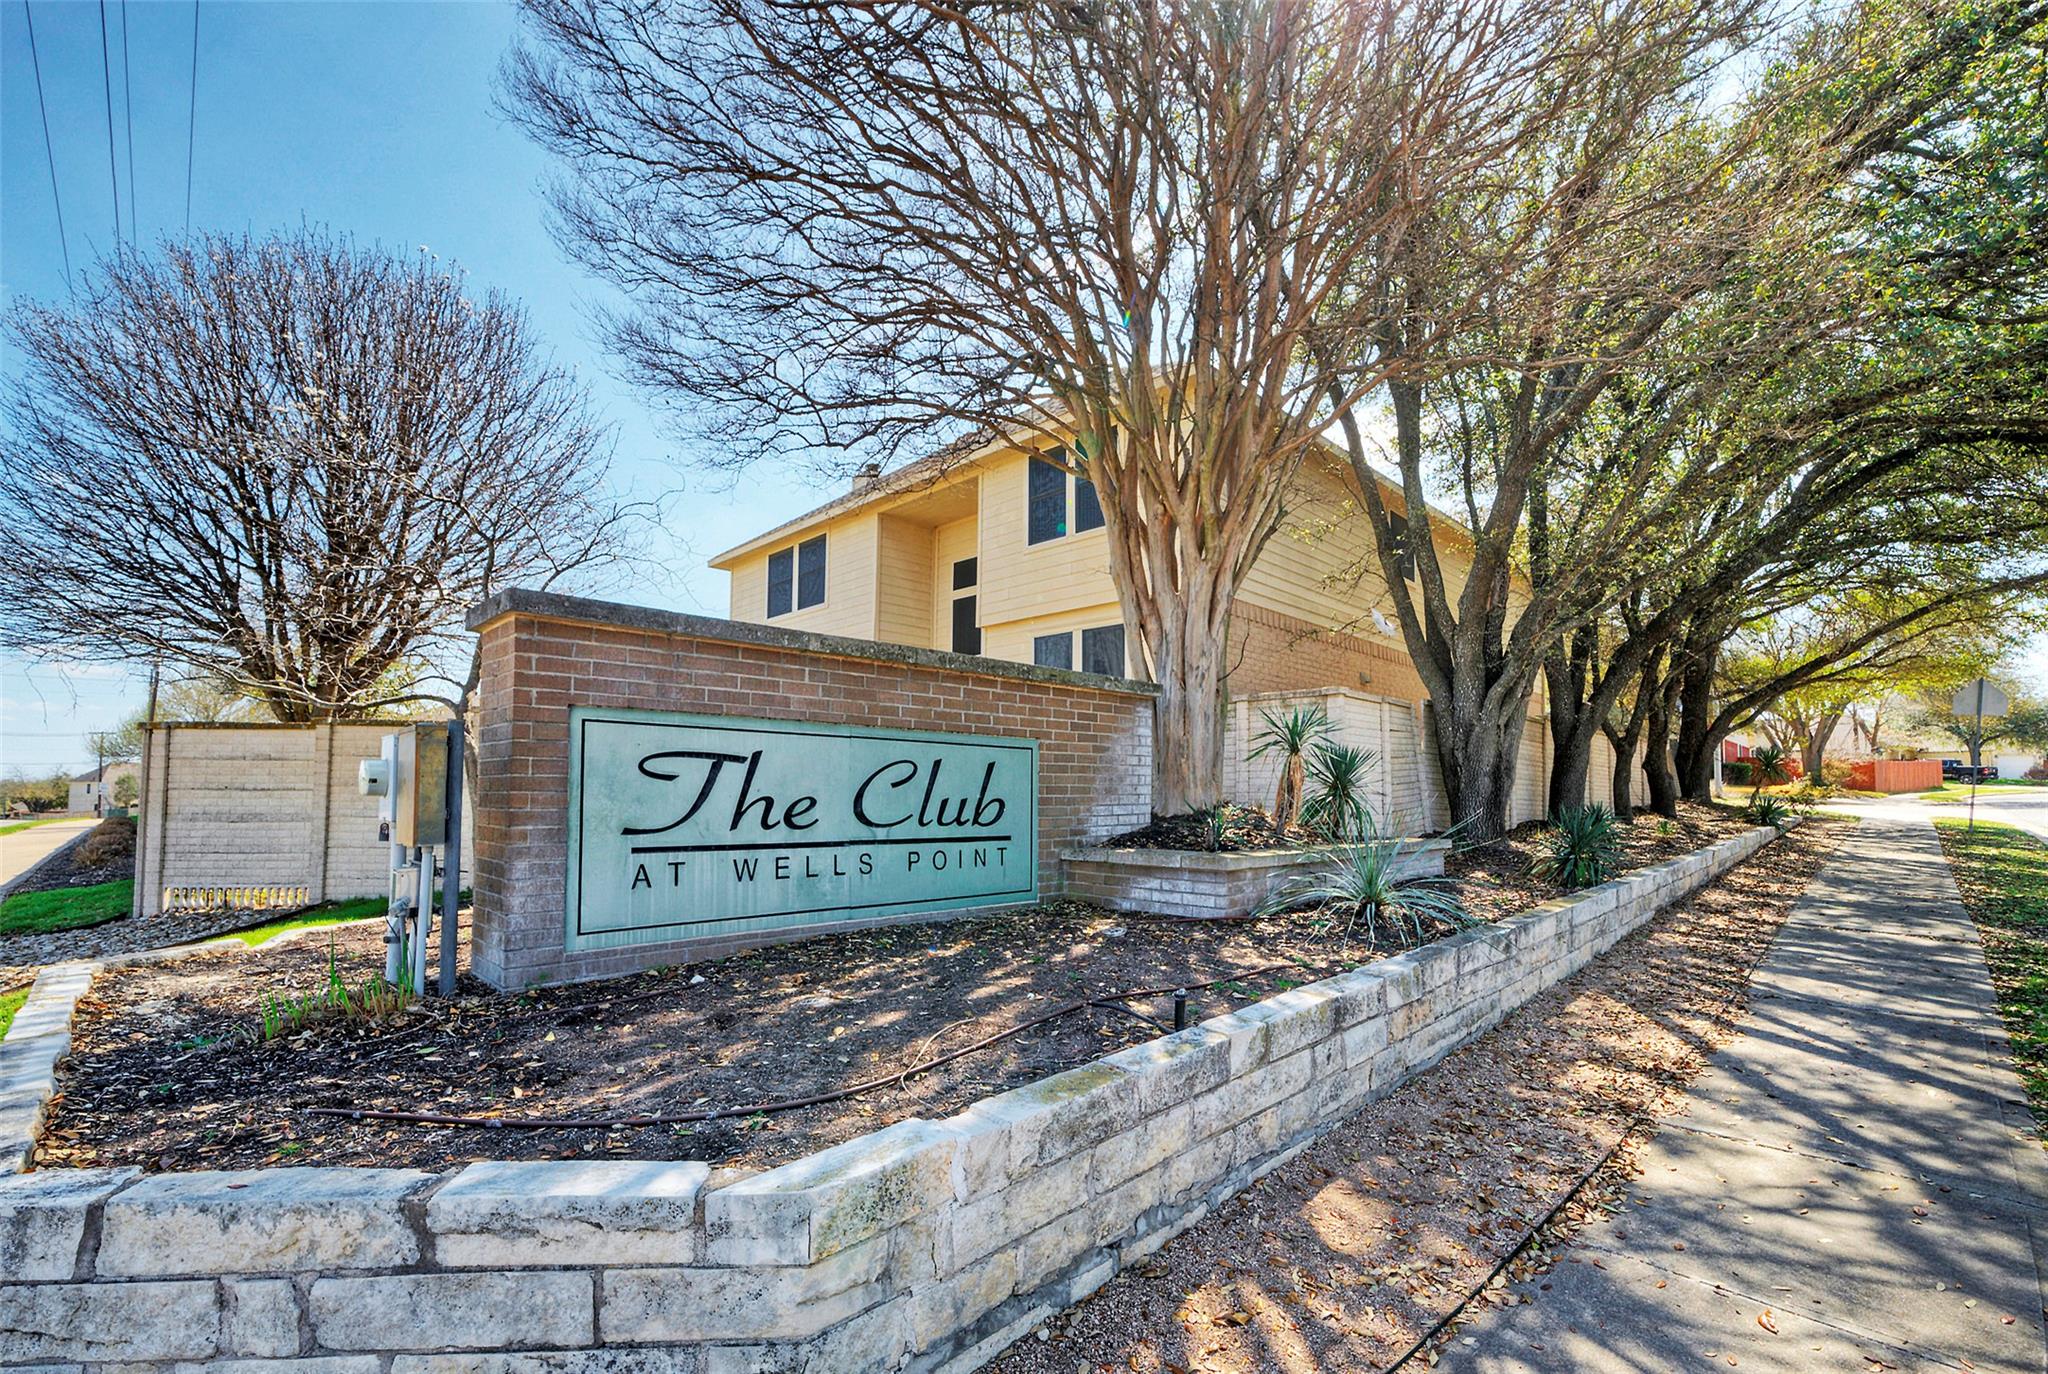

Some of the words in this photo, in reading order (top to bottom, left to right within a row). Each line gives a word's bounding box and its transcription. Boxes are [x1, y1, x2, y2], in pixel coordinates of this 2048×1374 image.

[621, 750, 819, 836] The
[853, 758, 1006, 829] Club
[631, 862, 686, 890] AT
[733, 852, 874, 882] WELLS
[908, 847, 1008, 873] POINT
